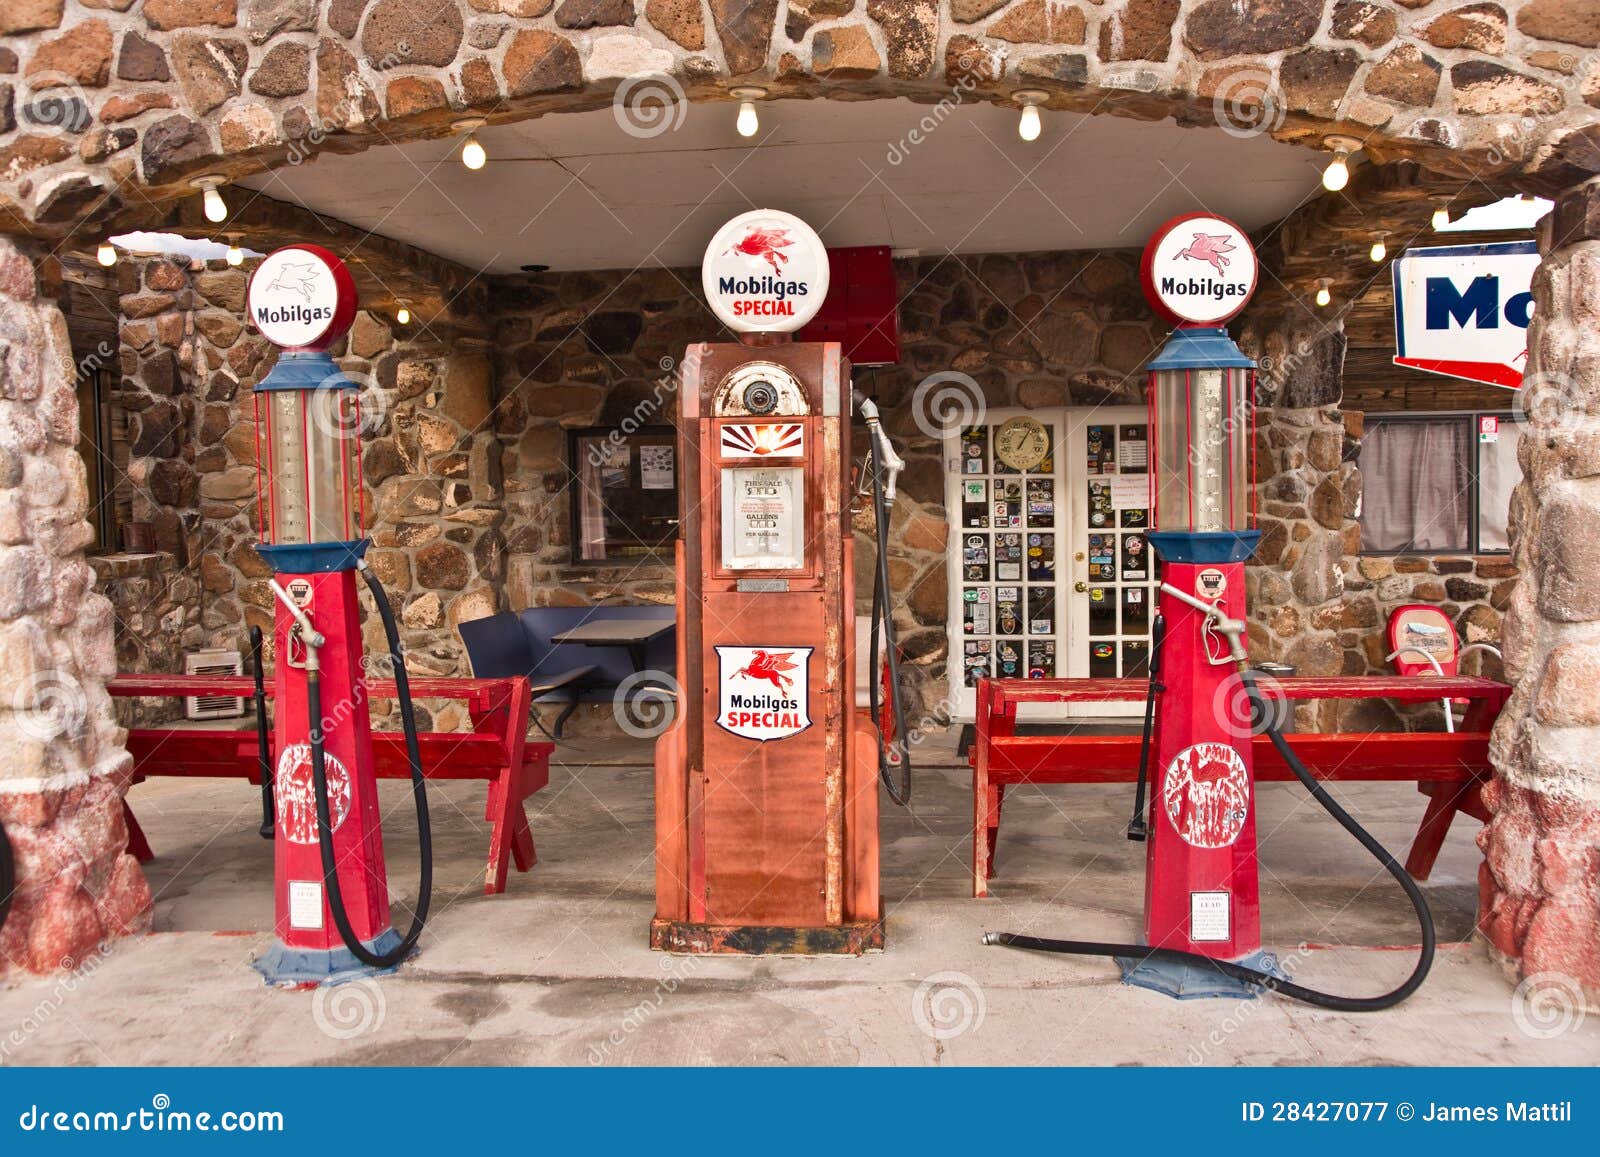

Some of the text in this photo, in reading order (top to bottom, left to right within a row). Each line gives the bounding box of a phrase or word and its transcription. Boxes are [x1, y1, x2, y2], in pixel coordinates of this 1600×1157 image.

[719, 276, 808, 300] Mobilgas
[1162, 277, 1247, 300] Mobilgas
[258, 305, 332, 325] Mobilgas
[733, 300, 795, 316] SPECIAL
[731, 694, 798, 712] Mobilgas
[728, 712, 802, 728] SPECIAL
